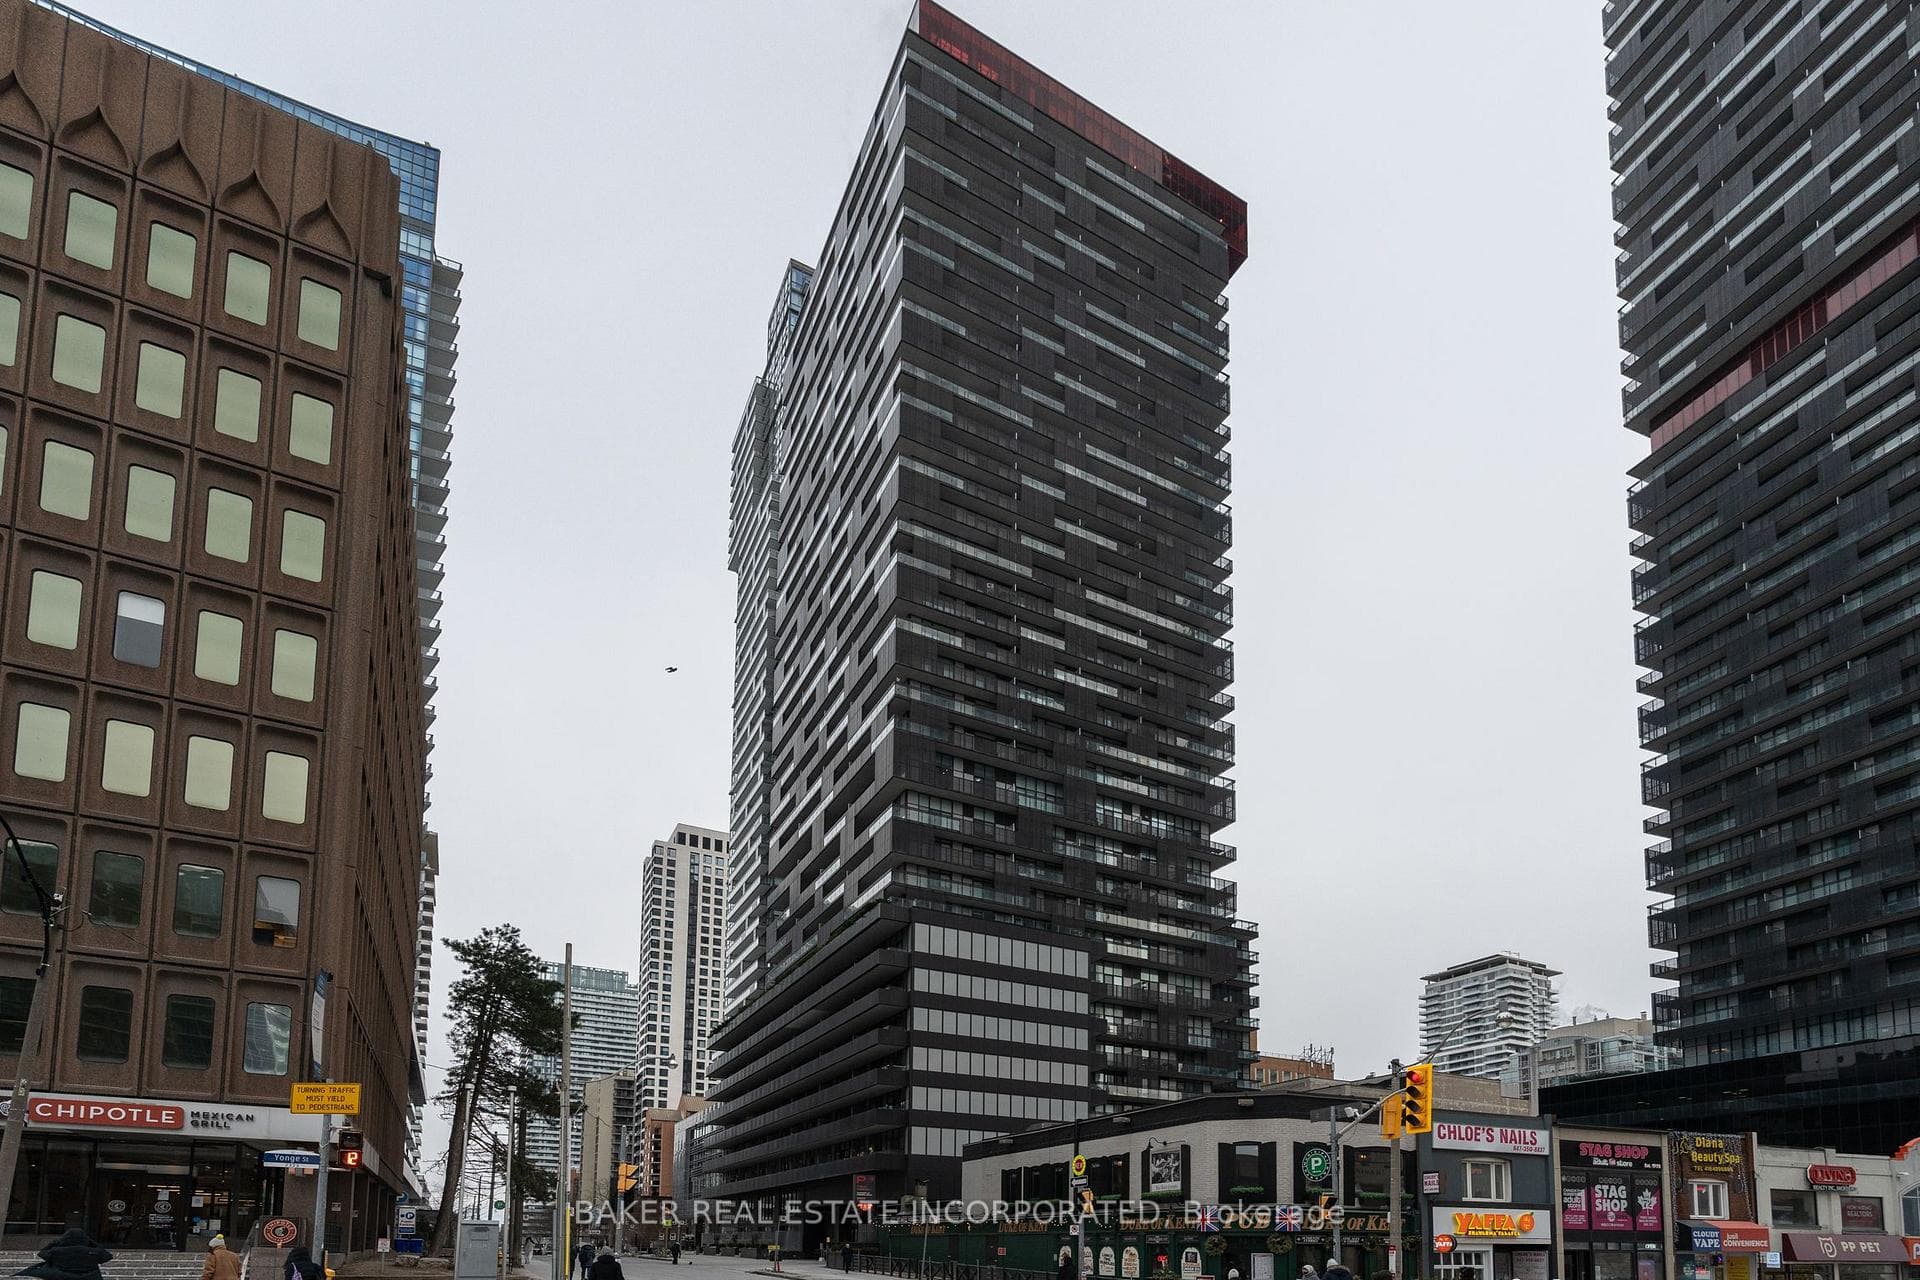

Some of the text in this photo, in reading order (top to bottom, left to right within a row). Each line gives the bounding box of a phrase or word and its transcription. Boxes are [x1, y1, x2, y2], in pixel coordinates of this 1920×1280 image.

[35, 1103, 176, 1123] CHIPOTLE
[190, 1111, 254, 1122] MEXICAN
[190, 1120, 231, 1129] GRILL
[1437, 1124, 1537, 1146] CHLOE'S NAILS
[1695, 1136, 1724, 1148] Diana
[1579, 1142, 1649, 1160] STAG SHOP
[1691, 1151, 1741, 1164] Beauty Spa
[274, 1154, 301, 1163] Yonge
[1311, 1158, 1322, 1171] P
[1595, 1185, 1627, 1198] STAG
[1595, 1199, 1628, 1212] SHOP
[1119, 1213, 1201, 1231] DUKE OF KENT
[1223, 1212, 1270, 1230] PUB
[1346, 1217, 1365, 1230] OF
[1366, 1214, 1405, 1231] KE
[1454, 1213, 1517, 1234] YAFFA
[1694, 1239, 1721, 1248] VAPE
[1841, 1242, 1881, 1253] PP PET
